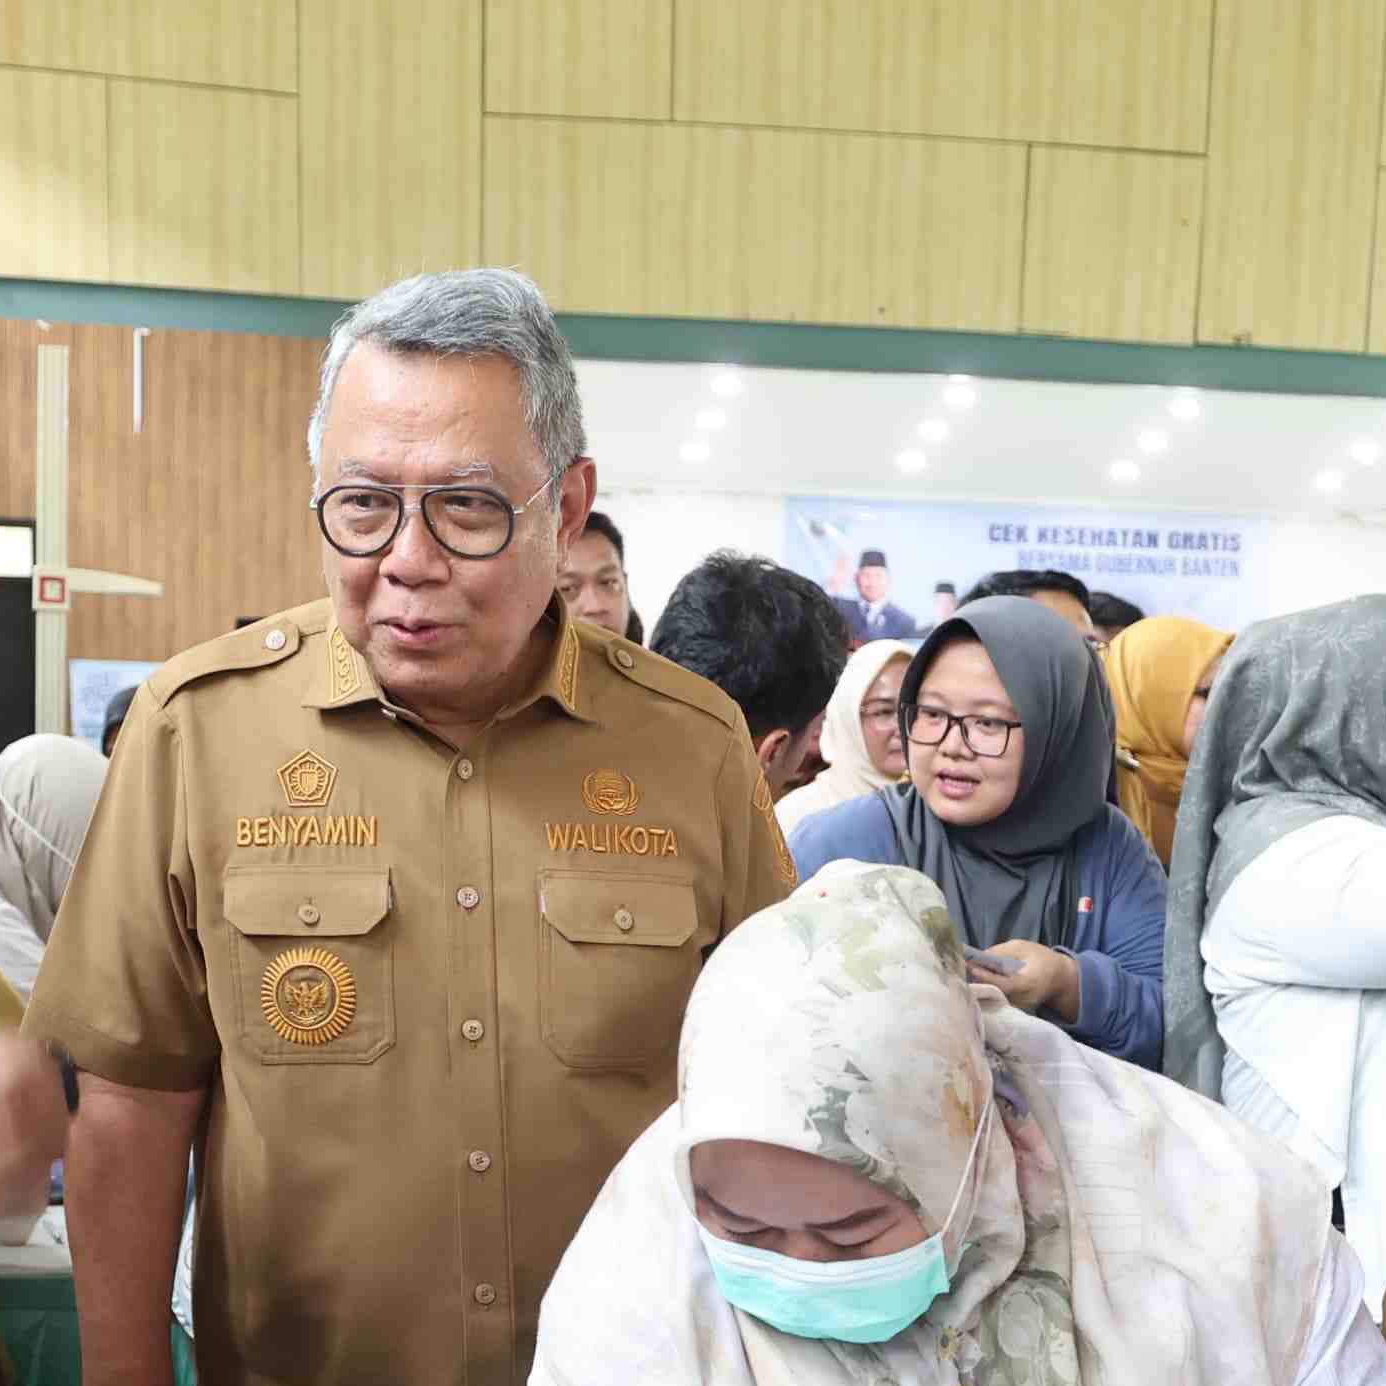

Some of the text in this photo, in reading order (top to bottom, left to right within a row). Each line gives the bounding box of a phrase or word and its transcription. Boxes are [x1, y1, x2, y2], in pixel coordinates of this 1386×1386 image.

[988, 523, 1241, 551] CEK KESEHATAN GRATIS
[236, 815, 377, 847] BENYAMIN
[545, 823, 678, 857] WALIKOTA
